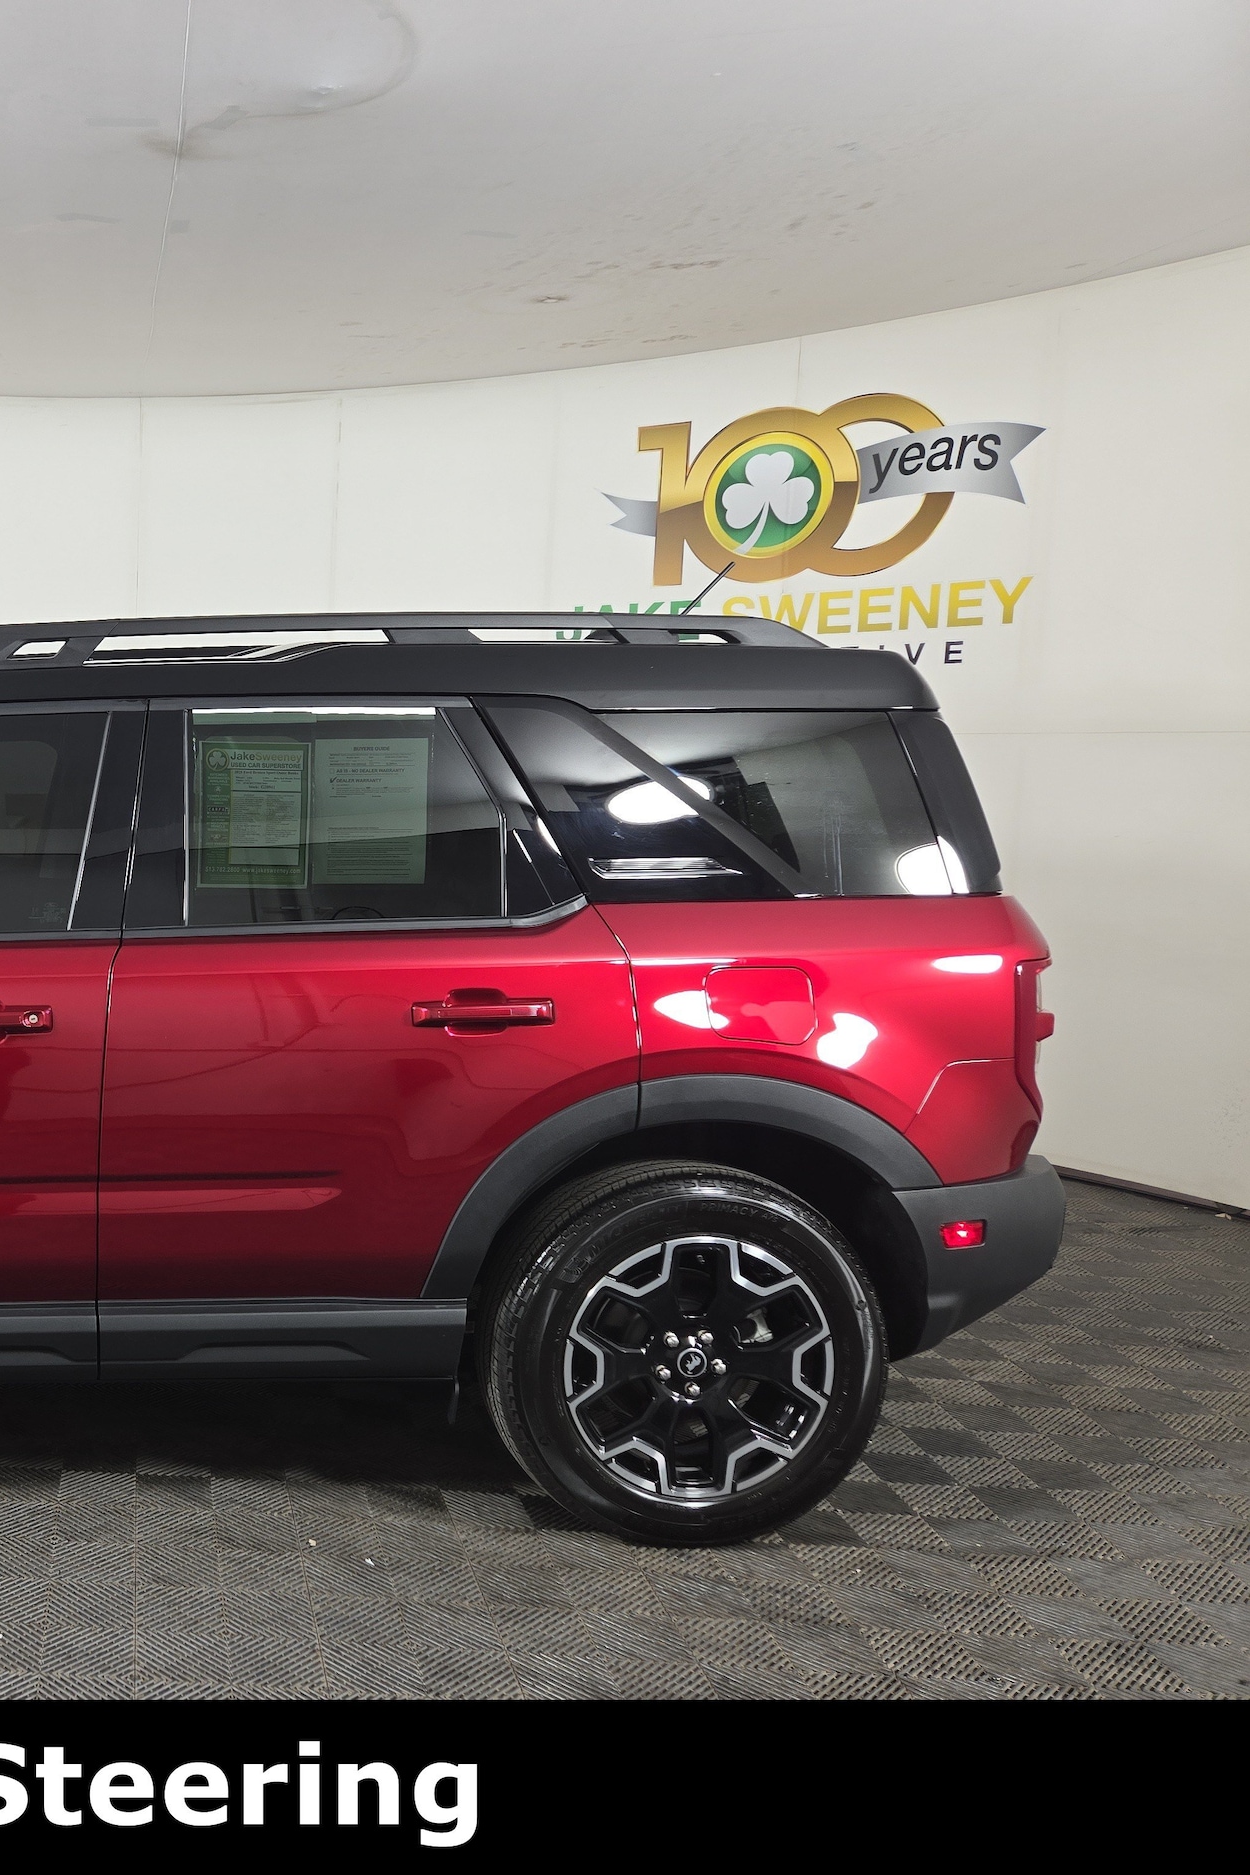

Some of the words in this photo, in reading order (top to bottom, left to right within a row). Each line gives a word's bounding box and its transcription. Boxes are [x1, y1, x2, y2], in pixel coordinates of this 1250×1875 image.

[638, 392, 954, 586] 100
[868, 433, 1001, 494] years
[698, 1201, 756, 1218] PRIMACY
